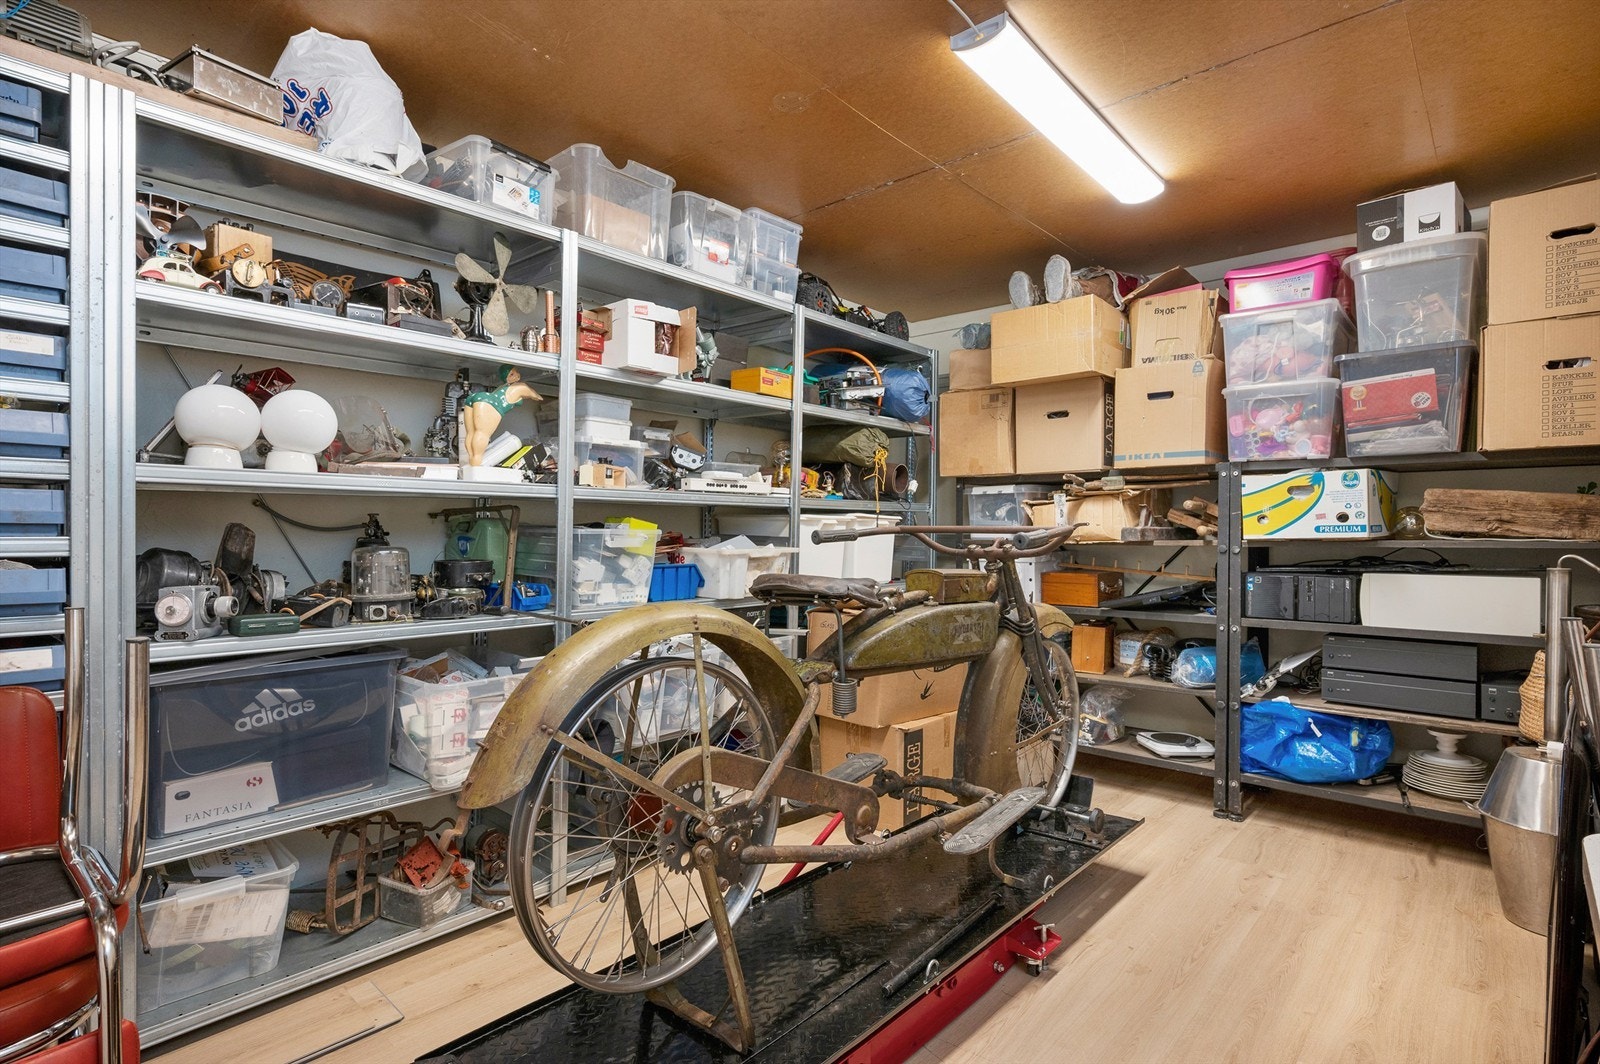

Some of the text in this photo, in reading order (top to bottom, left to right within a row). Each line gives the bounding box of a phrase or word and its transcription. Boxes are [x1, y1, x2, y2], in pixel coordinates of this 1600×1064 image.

[1555, 249, 1577, 257] STUE
[1555, 256, 1577, 265] LOFT
[1555, 260, 1599, 271] AVDELING
[1555, 289, 1596, 299] KJELLER
[1555, 298, 1588, 307] ETASJE
[1552, 372, 1594, 380] KJØKKEN
[1552, 393, 1595, 402] AVDELING
[1105, 393, 1114, 458] LARGE
[1128, 452, 1161, 461] IKEA
[1319, 525, 1361, 533] PREMIUM
[234, 699, 316, 732] adidas
[184, 801, 253, 823] FANTASIA
